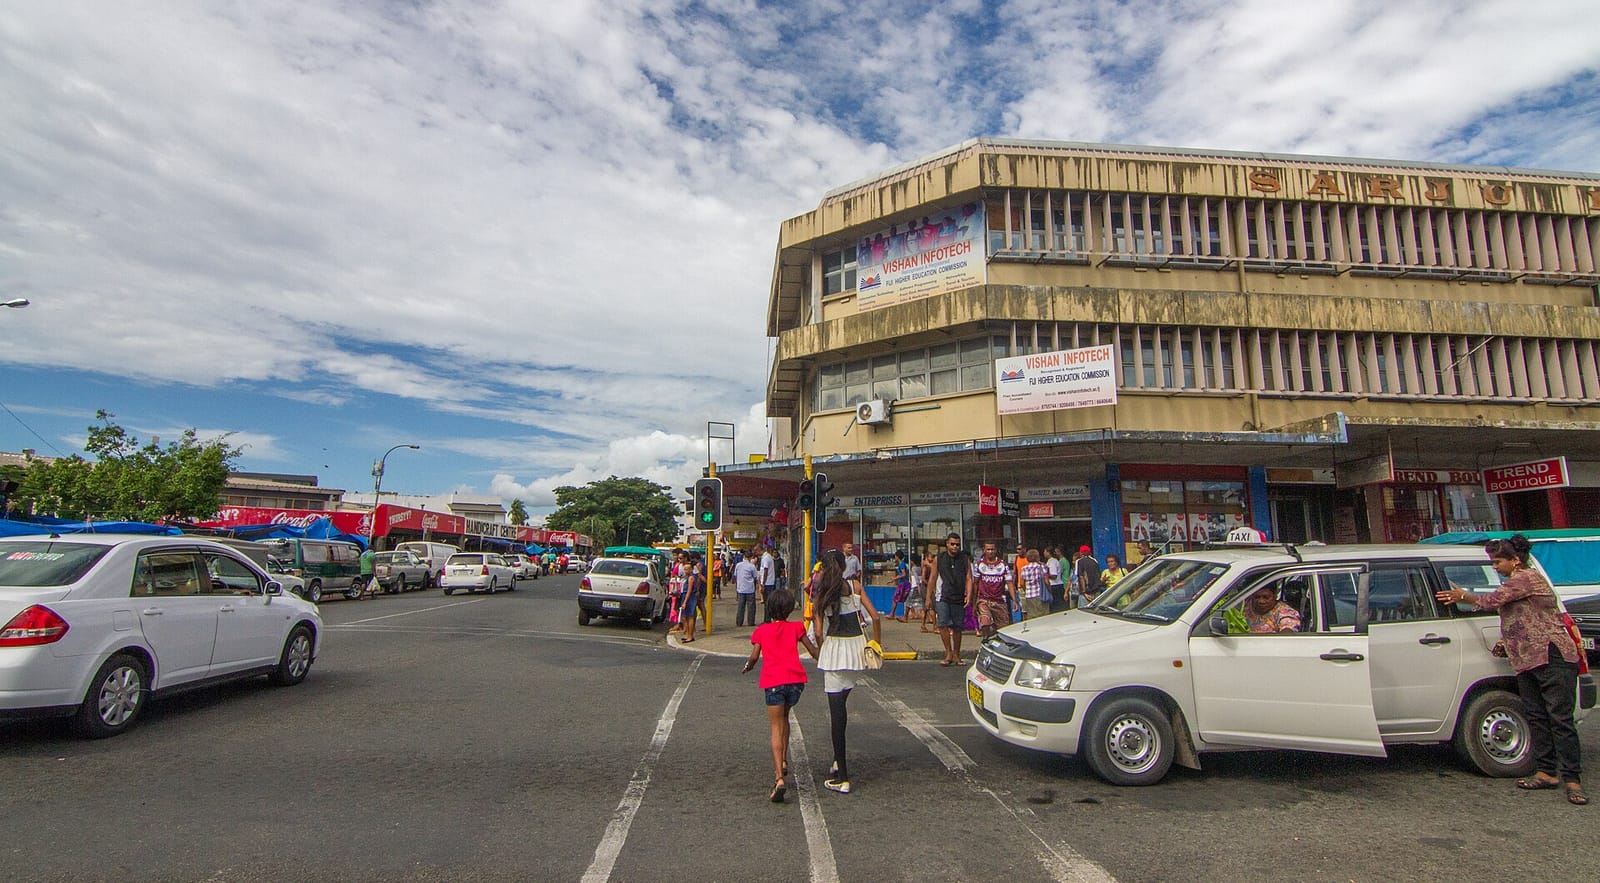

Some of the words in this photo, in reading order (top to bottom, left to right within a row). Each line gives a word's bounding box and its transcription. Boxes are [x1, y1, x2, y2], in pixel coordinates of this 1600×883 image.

[1250, 170, 1512, 205] SARJU
[883, 256, 918, 274] VISHAN
[920, 240, 971, 265] INFOTECH
[895, 276, 910, 284] HIGHER
[912, 270, 937, 281] EDUCATION
[939, 261, 967, 274] COMMISSION
[1026, 354, 1059, 369] VISHAN
[1064, 348, 1110, 366] INFOTECH
[1029, 378, 1037, 386] FIJI
[1038, 376, 1054, 384] HIGHER
[1056, 373, 1080, 383] EDUCATION
[1081, 370, 1110, 380] COMMISSION
[1494, 464, 1549, 479] TREND
[1490, 474, 1558, 491] BOUTIQUE
[854, 496, 902, 506] ENTERPRISES
[466, 520, 498, 536] HANDICRAFT
[501, 526, 516, 538] CENTRE
[1230, 533, 1250, 541] TAXI
